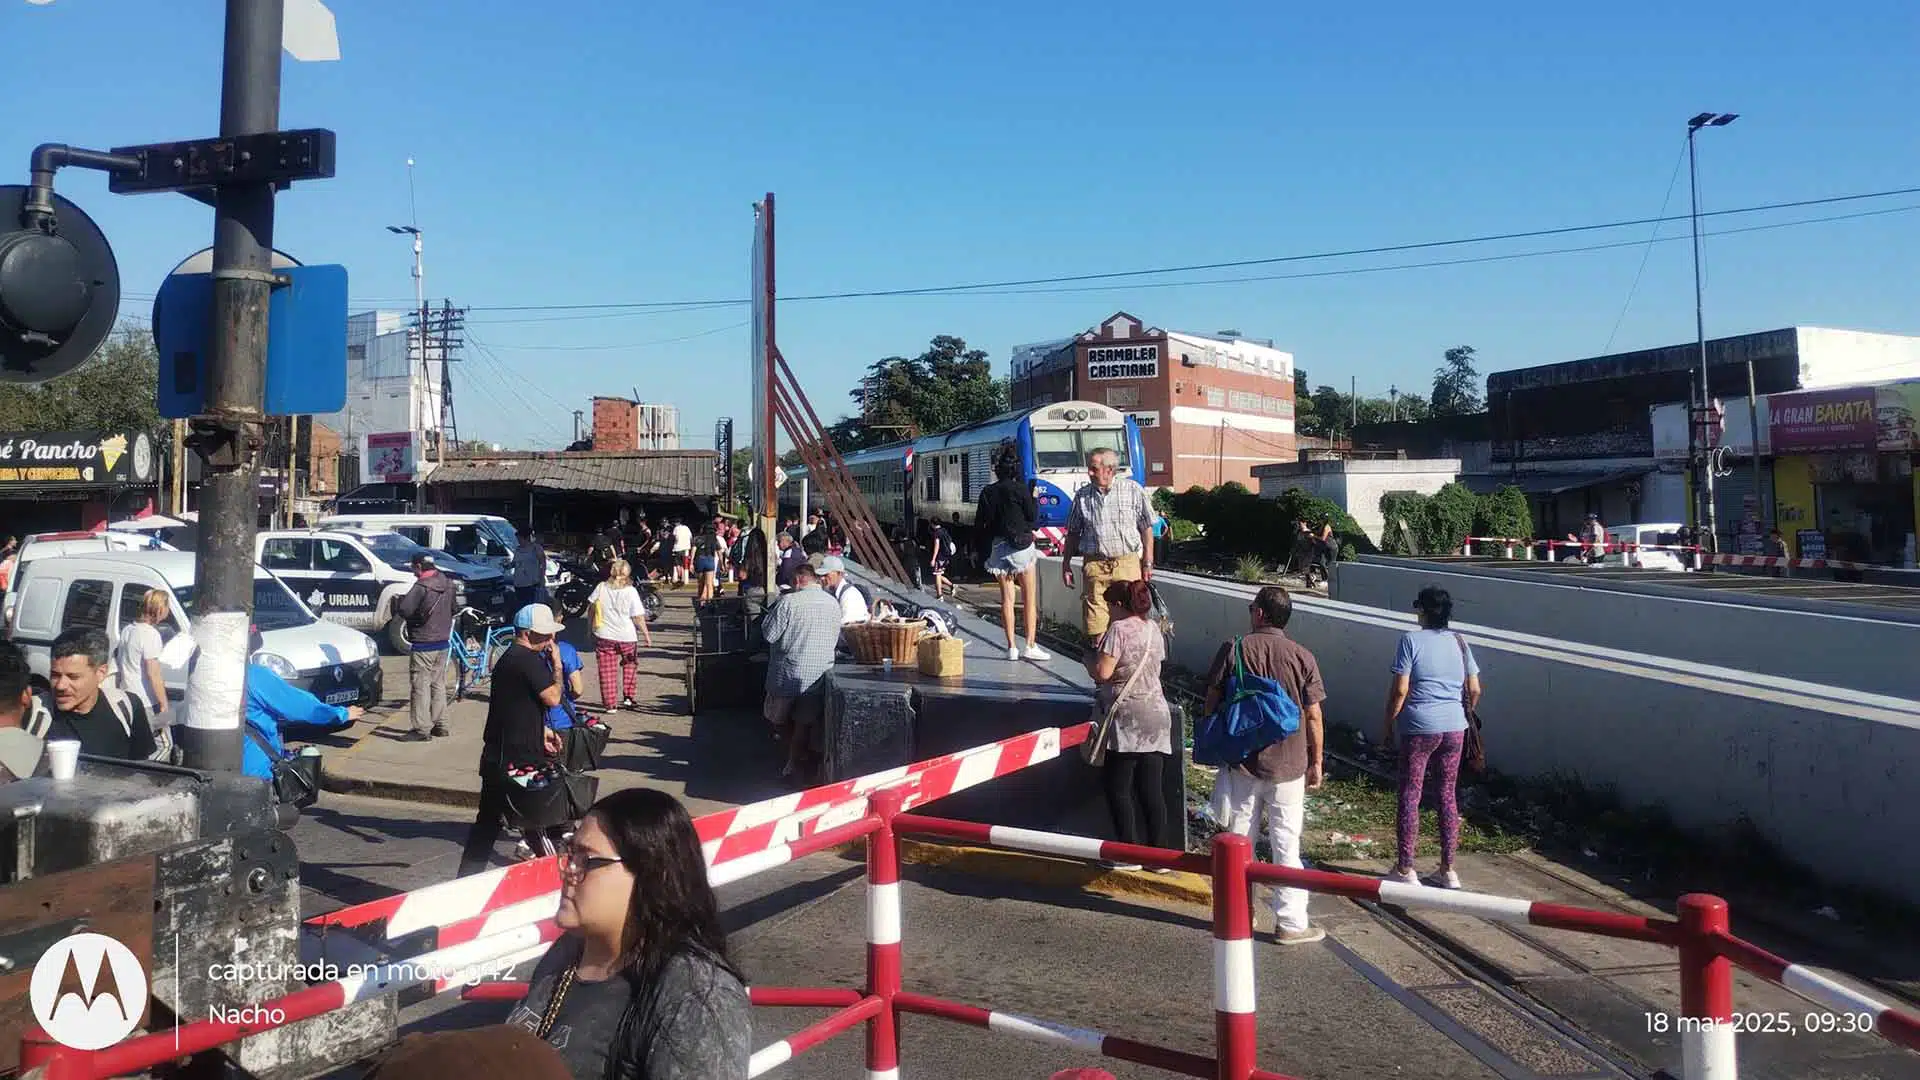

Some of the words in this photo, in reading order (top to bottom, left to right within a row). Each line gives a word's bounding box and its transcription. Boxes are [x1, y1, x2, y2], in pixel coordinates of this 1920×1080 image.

[1088, 347, 1156, 362] ASAMBLEA
[1090, 363, 1156, 378] CRISTIANA
[1769, 408, 1781, 425] LA
[1783, 406, 1813, 425] GRAN
[1815, 400, 1873, 424] BARATA
[19, 439, 97, 460] Pancho
[329, 594, 370, 606] URBANA
